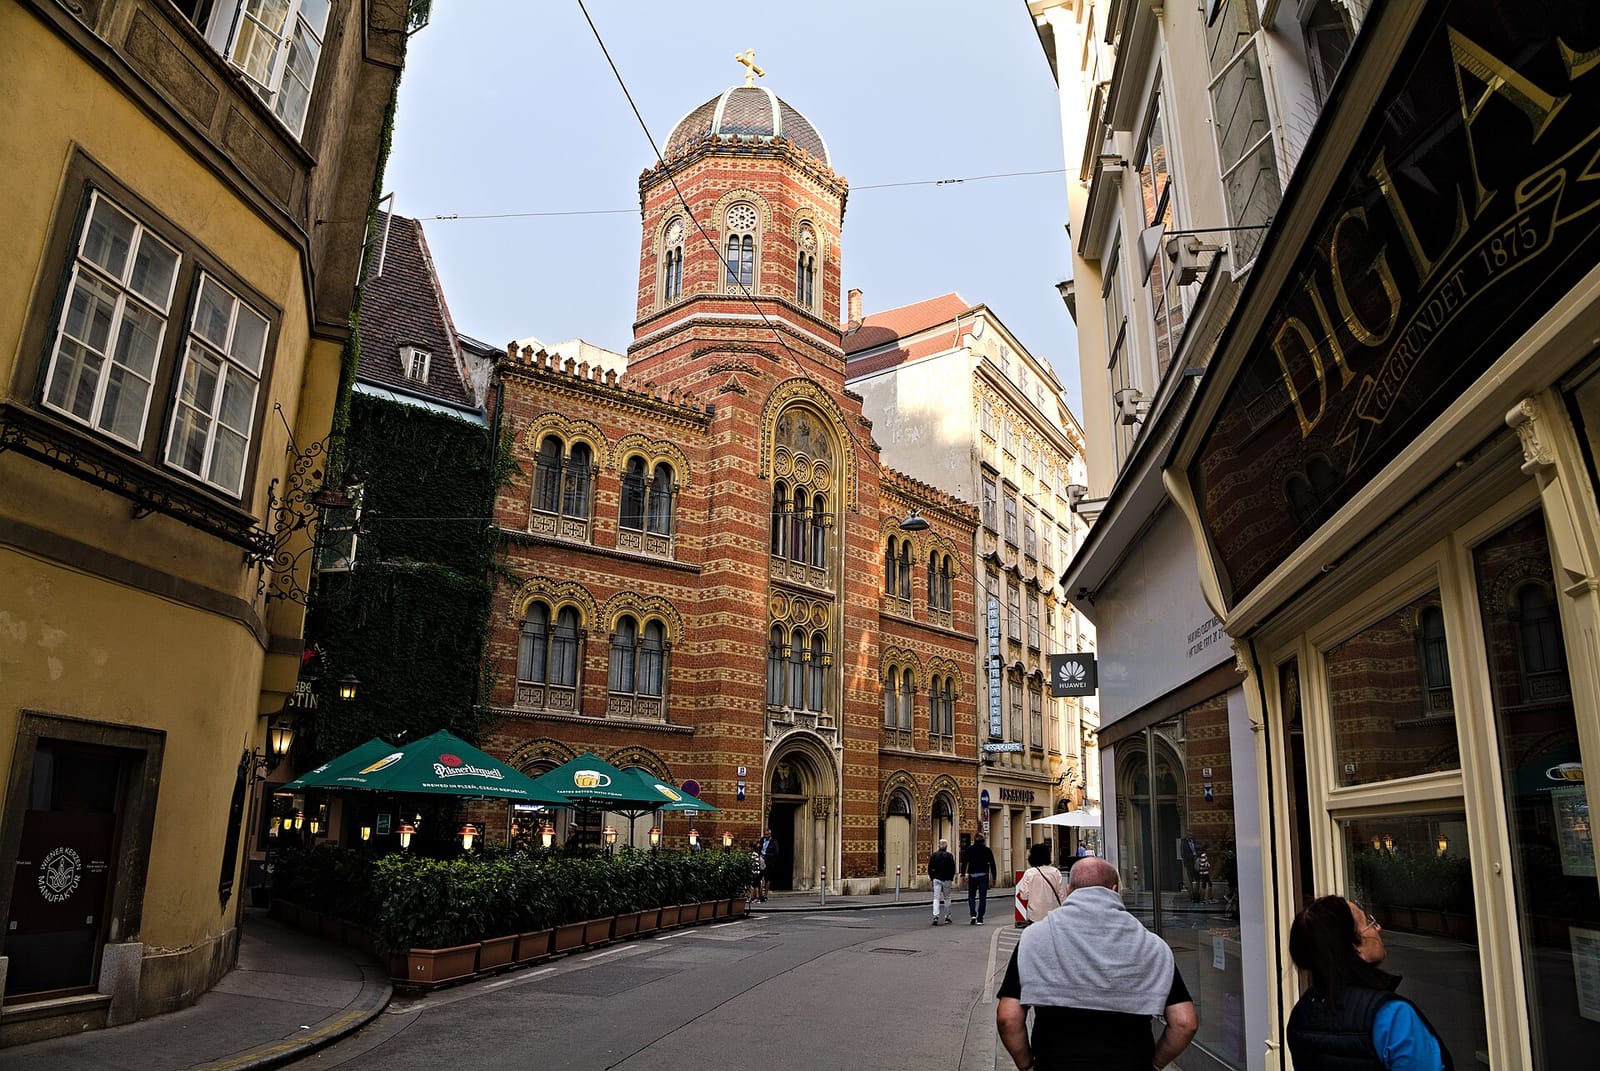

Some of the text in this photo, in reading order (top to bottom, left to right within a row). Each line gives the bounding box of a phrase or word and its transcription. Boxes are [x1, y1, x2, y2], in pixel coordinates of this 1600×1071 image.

[1271, 23, 1600, 439] DIGLA
[1478, 215, 1538, 277] 1875
[433, 762, 467, 779] Pilsner
[40, 847, 82, 871] WIENER KERZEN
[38, 875, 81, 902] MANUFAKTUR
